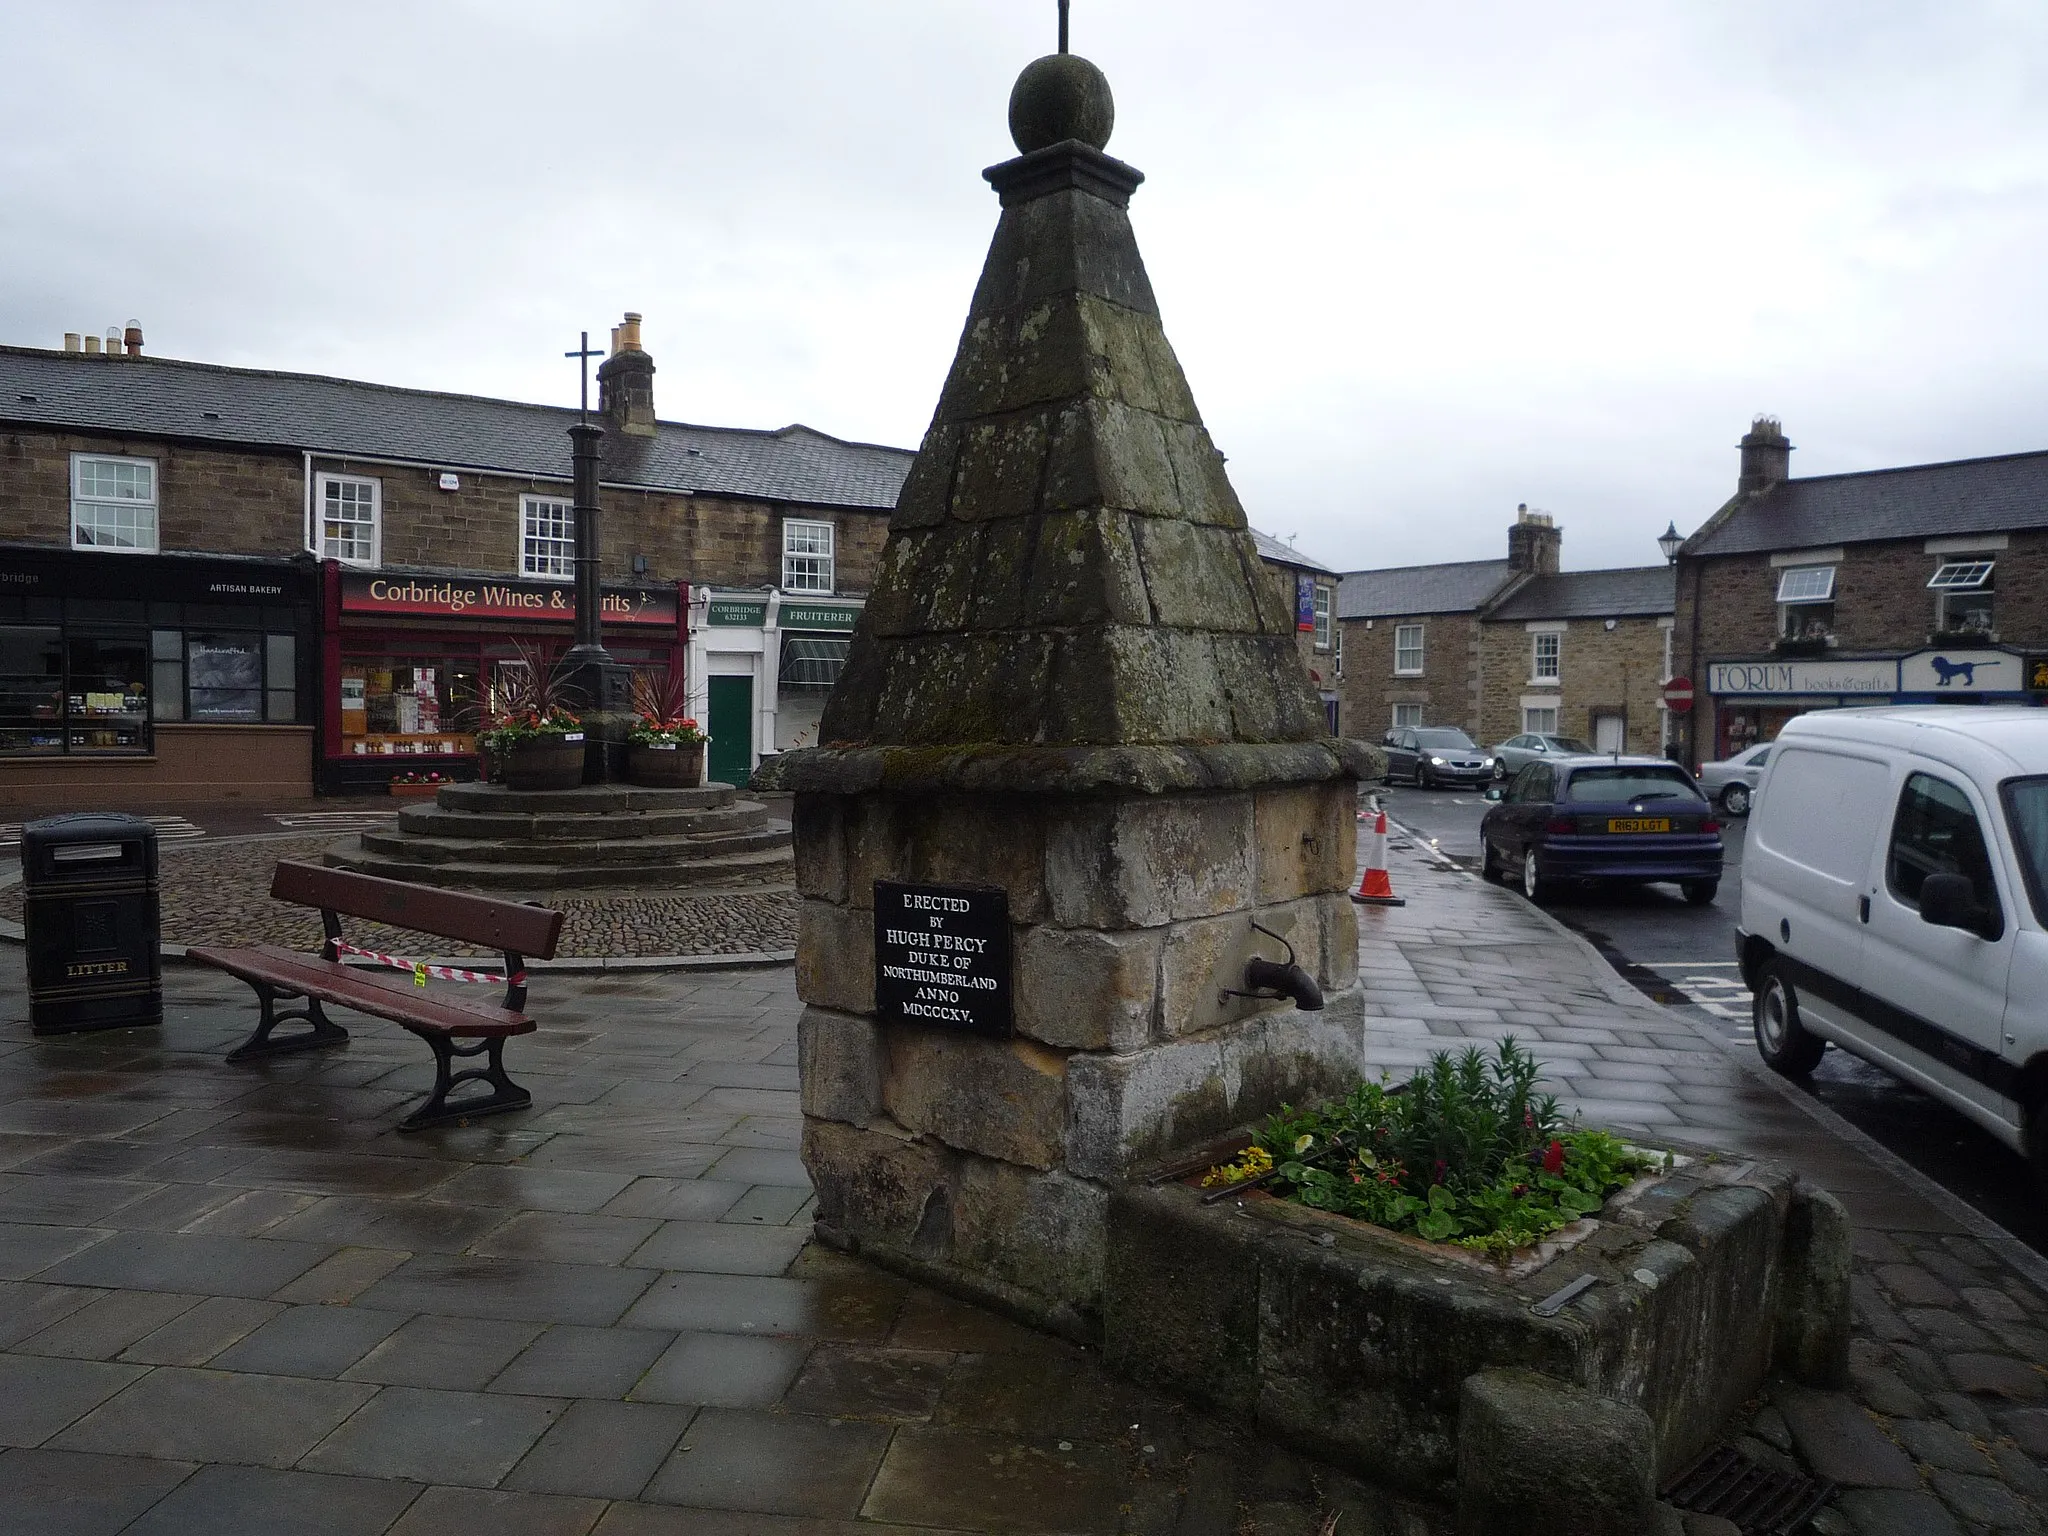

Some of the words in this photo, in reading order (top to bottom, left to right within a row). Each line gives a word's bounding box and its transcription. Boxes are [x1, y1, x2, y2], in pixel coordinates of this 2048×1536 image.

[0, 571, 39, 585] bridge
[209, 583, 247, 593] ARTISAN
[249, 585, 283, 595] BAKERY
[370, 580, 476, 611] Corbridge
[484, 585, 544, 608] Wines
[550, 590, 566, 609] &
[572, 593, 631, 612] rits
[711, 605, 762, 614] CORBRIDGE
[789, 611, 853, 623] FRUITERER
[1716, 664, 1794, 691] FORUM
[1614, 820, 1639, 832] R163
[903, 894, 970, 913] ERECTED
[929, 916, 944, 929] BY
[886, 929, 930, 948] HUGH
[933, 934, 987, 953] PERCY
[67, 961, 129, 976] LITTER
[908, 951, 950, 967] DUKE
[953, 956, 972, 970] OF
[883, 965, 998, 990] NORTHUMBERLAND
[915, 987, 960, 1003] ANNO
[902, 1001, 974, 1023] MDCCCXV.
